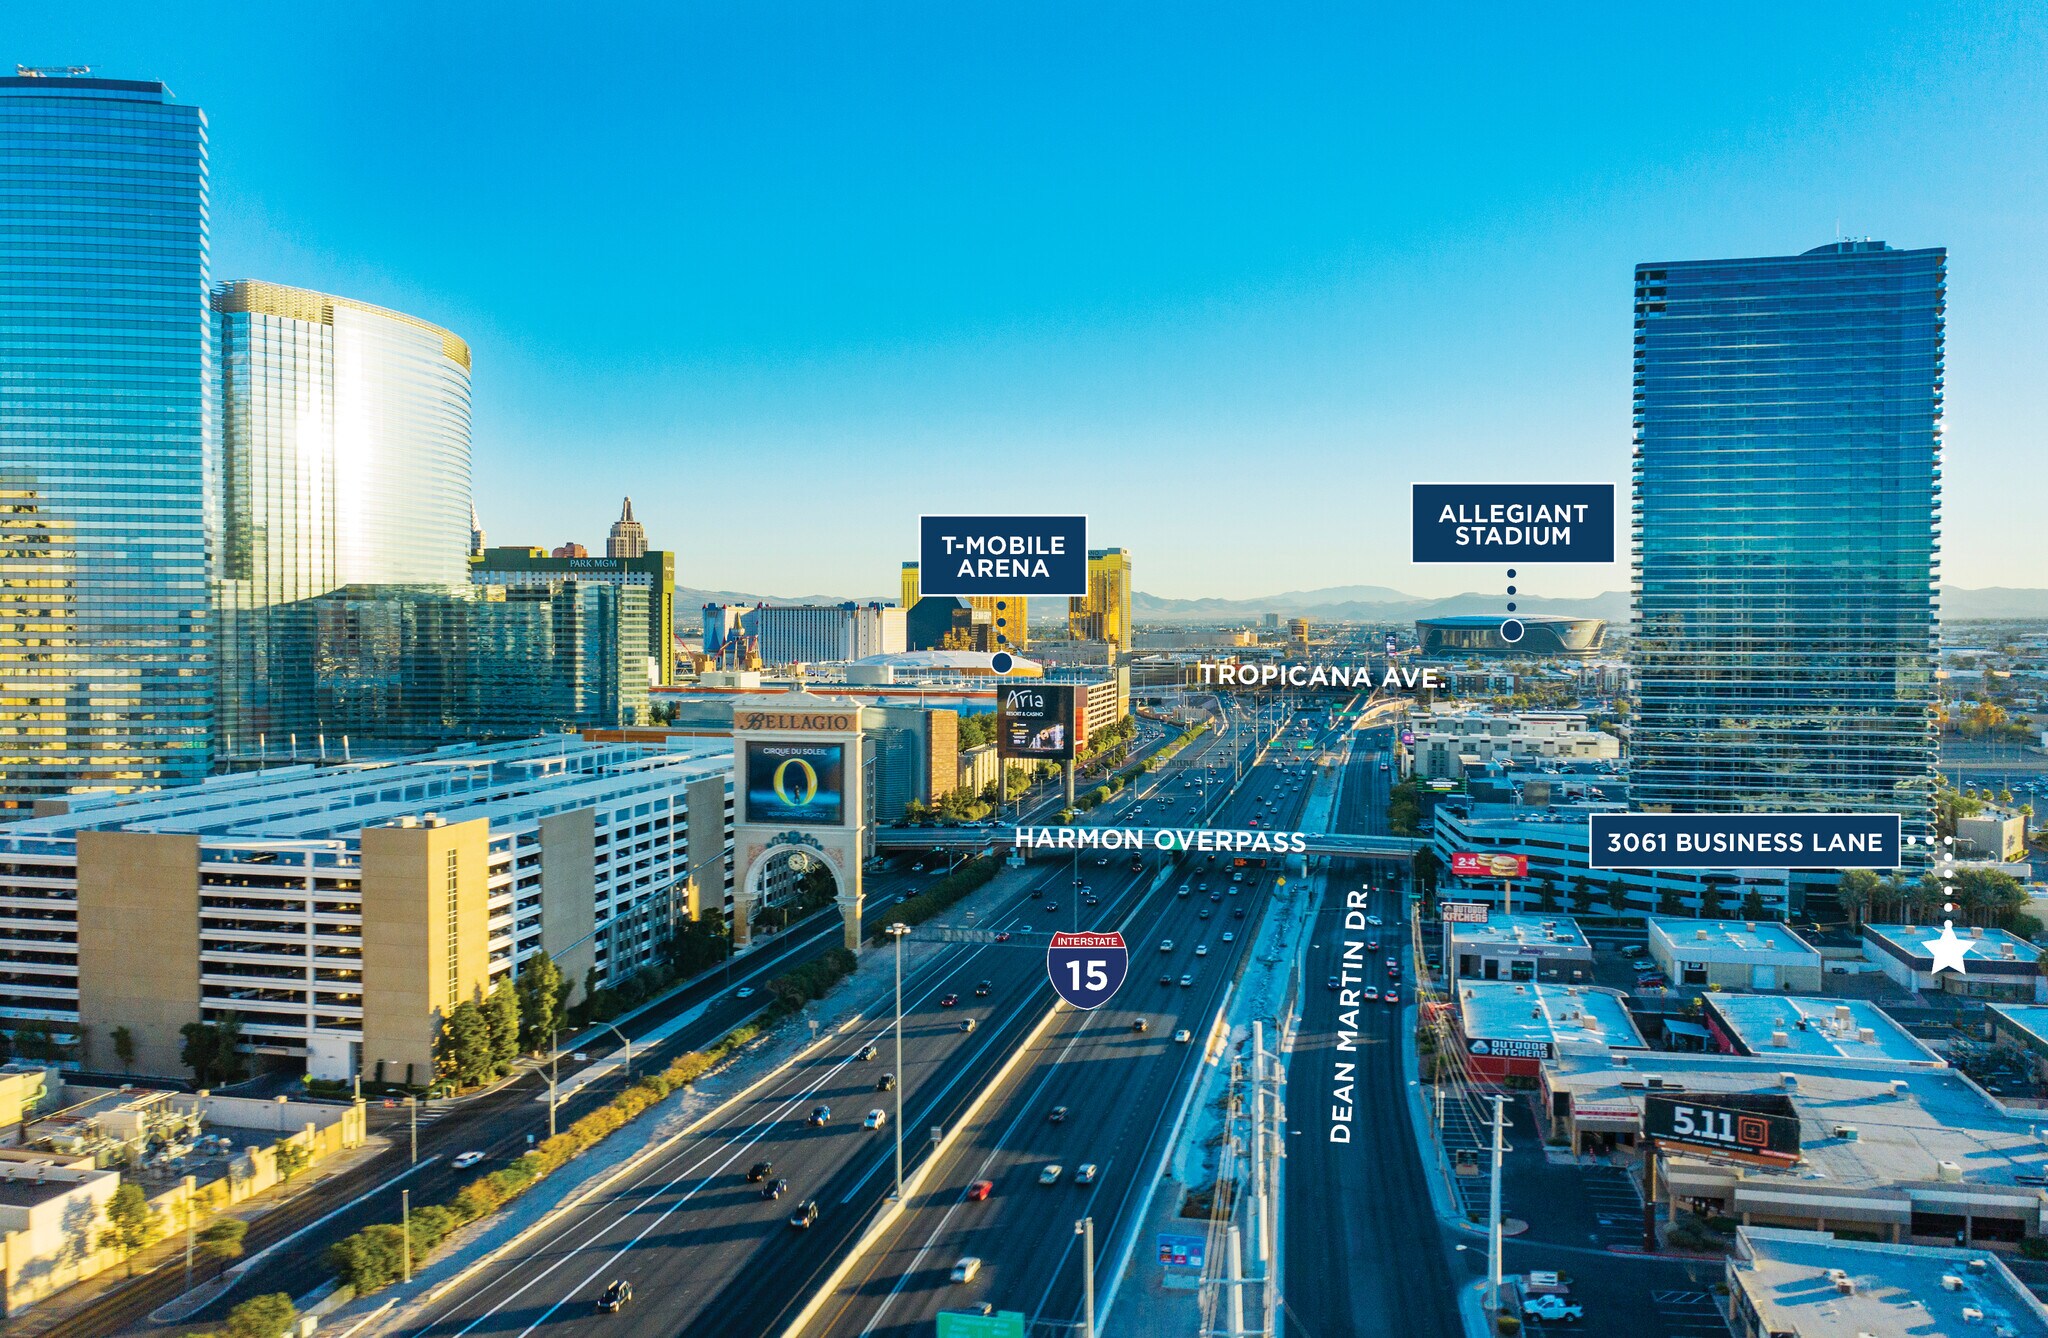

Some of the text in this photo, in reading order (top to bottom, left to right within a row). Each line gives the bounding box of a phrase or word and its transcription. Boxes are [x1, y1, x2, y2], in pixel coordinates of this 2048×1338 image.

[570, 559, 617, 568] PARK MGM
[740, 712, 848, 731] BELLAGIO
[763, 747, 789, 757] CIRQUE
[803, 748, 827, 756] SOLEIL
[773, 758, 818, 807] O
[1453, 906, 1487, 914] OUTDOOR
[1443, 912, 1488, 923] KITCHENS
[1491, 1040, 1548, 1051] OUTDOOR
[1491, 1048, 1548, 1059] KITCHENS
[1673, 1106, 1736, 1142] 5.11
